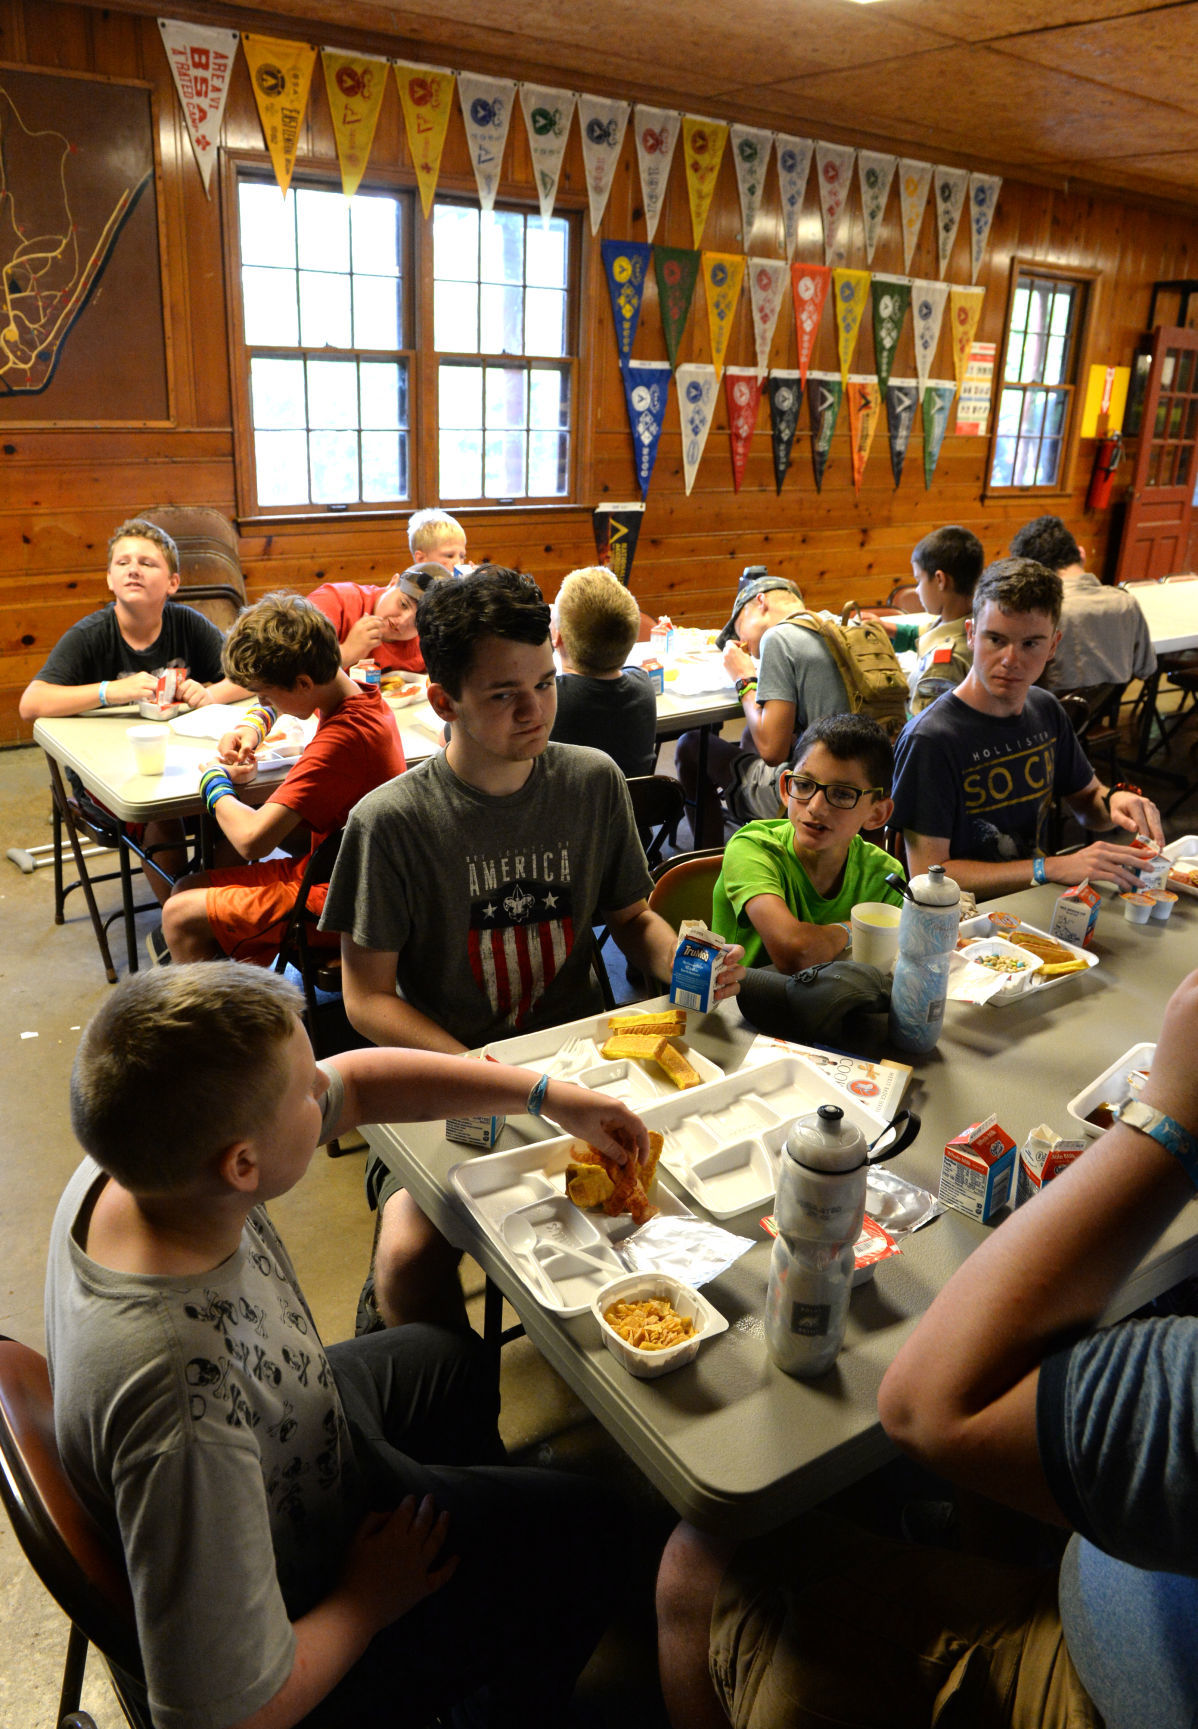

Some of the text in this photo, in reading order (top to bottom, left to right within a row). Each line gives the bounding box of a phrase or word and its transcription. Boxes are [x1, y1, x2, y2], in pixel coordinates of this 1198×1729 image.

[174, 61, 195, 99] RATED
[190, 46, 211, 124] BSA
[209, 50, 230, 93] AREA
[963, 767, 1013, 807] SO
[468, 848, 571, 896] AMERICA
